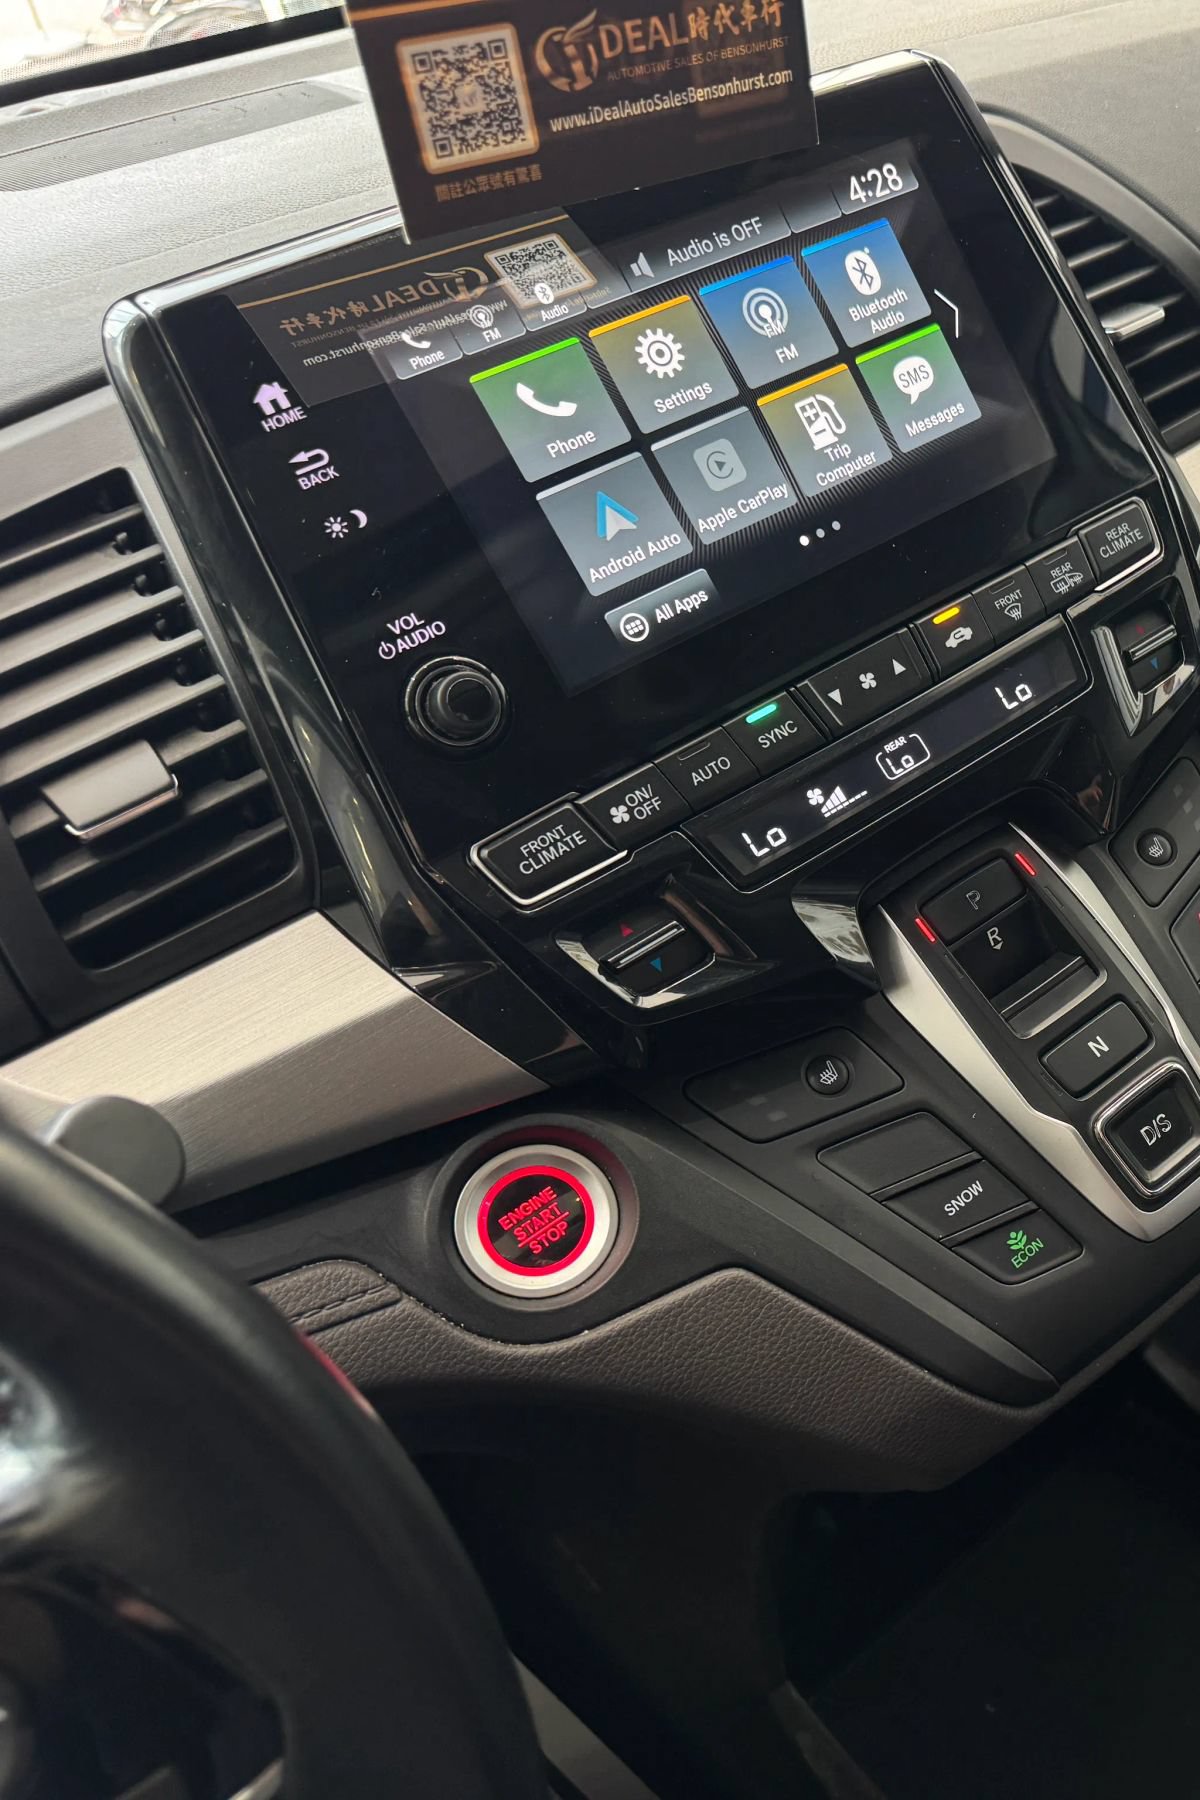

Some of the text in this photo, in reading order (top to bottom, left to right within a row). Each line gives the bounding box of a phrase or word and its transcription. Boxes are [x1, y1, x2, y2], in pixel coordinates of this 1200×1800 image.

[607, 36, 790, 82] AUTOMOTIVE SALES OF BENSONHURST
[550, 69, 793, 132] www.iDealAutoSalesBensonhurst.com
[849, 163, 903, 204] 4:28
[666, 216, 763, 267] Audio is OFF
[540, 304, 569, 322] Audio
[848, 288, 908, 322] Bluetooth
[482, 327, 502, 342] FM
[869, 310, 905, 334] Audio
[409, 349, 445, 370] Phone
[775, 342, 799, 363] FM
[898, 364, 930, 389] SMS
[653, 380, 713, 415] Settings
[261, 406, 307, 432] HOME
[905, 403, 965, 437] Messages
[546, 428, 597, 459] Phone
[824, 442, 852, 465] Trip
[297, 465, 340, 490] BACK
[816, 450, 877, 488] Computer
[697, 481, 789, 534] Apple CarPlay
[1100, 528, 1144, 559] CLIMATE
[1105, 522, 1130, 542] REAR
[588, 530, 681, 583] Android Auto
[1050, 561, 1073, 578] REAR
[654, 588, 709, 623] All Apps
[994, 589, 1022, 610] FRONT
[387, 612, 425, 635] VOL
[396, 621, 446, 653] AUDIO
[994, 683, 1033, 710] Lo
[757, 720, 798, 749] SYNC
[883, 735, 908, 754] REAR
[691, 756, 731, 786] AUTO
[885, 754, 915, 775] Lo
[625, 784, 655, 809] ON/
[633, 797, 663, 821] OFF
[518, 830, 587, 875] CLIMATE
[519, 824, 567, 858] FRONT
[741, 826, 788, 857] Lo
[965, 889, 982, 911] P
[987, 926, 1003, 947] R
[1087, 1036, 1110, 1058] N
[1140, 1113, 1172, 1146] D/S
[498, 1186, 557, 1231] ENGINE
[944, 1180, 984, 1218] SNOW
[513, 1202, 562, 1241] START
[529, 1221, 568, 1255] STOP
[1010, 1237, 1045, 1269] ECON
